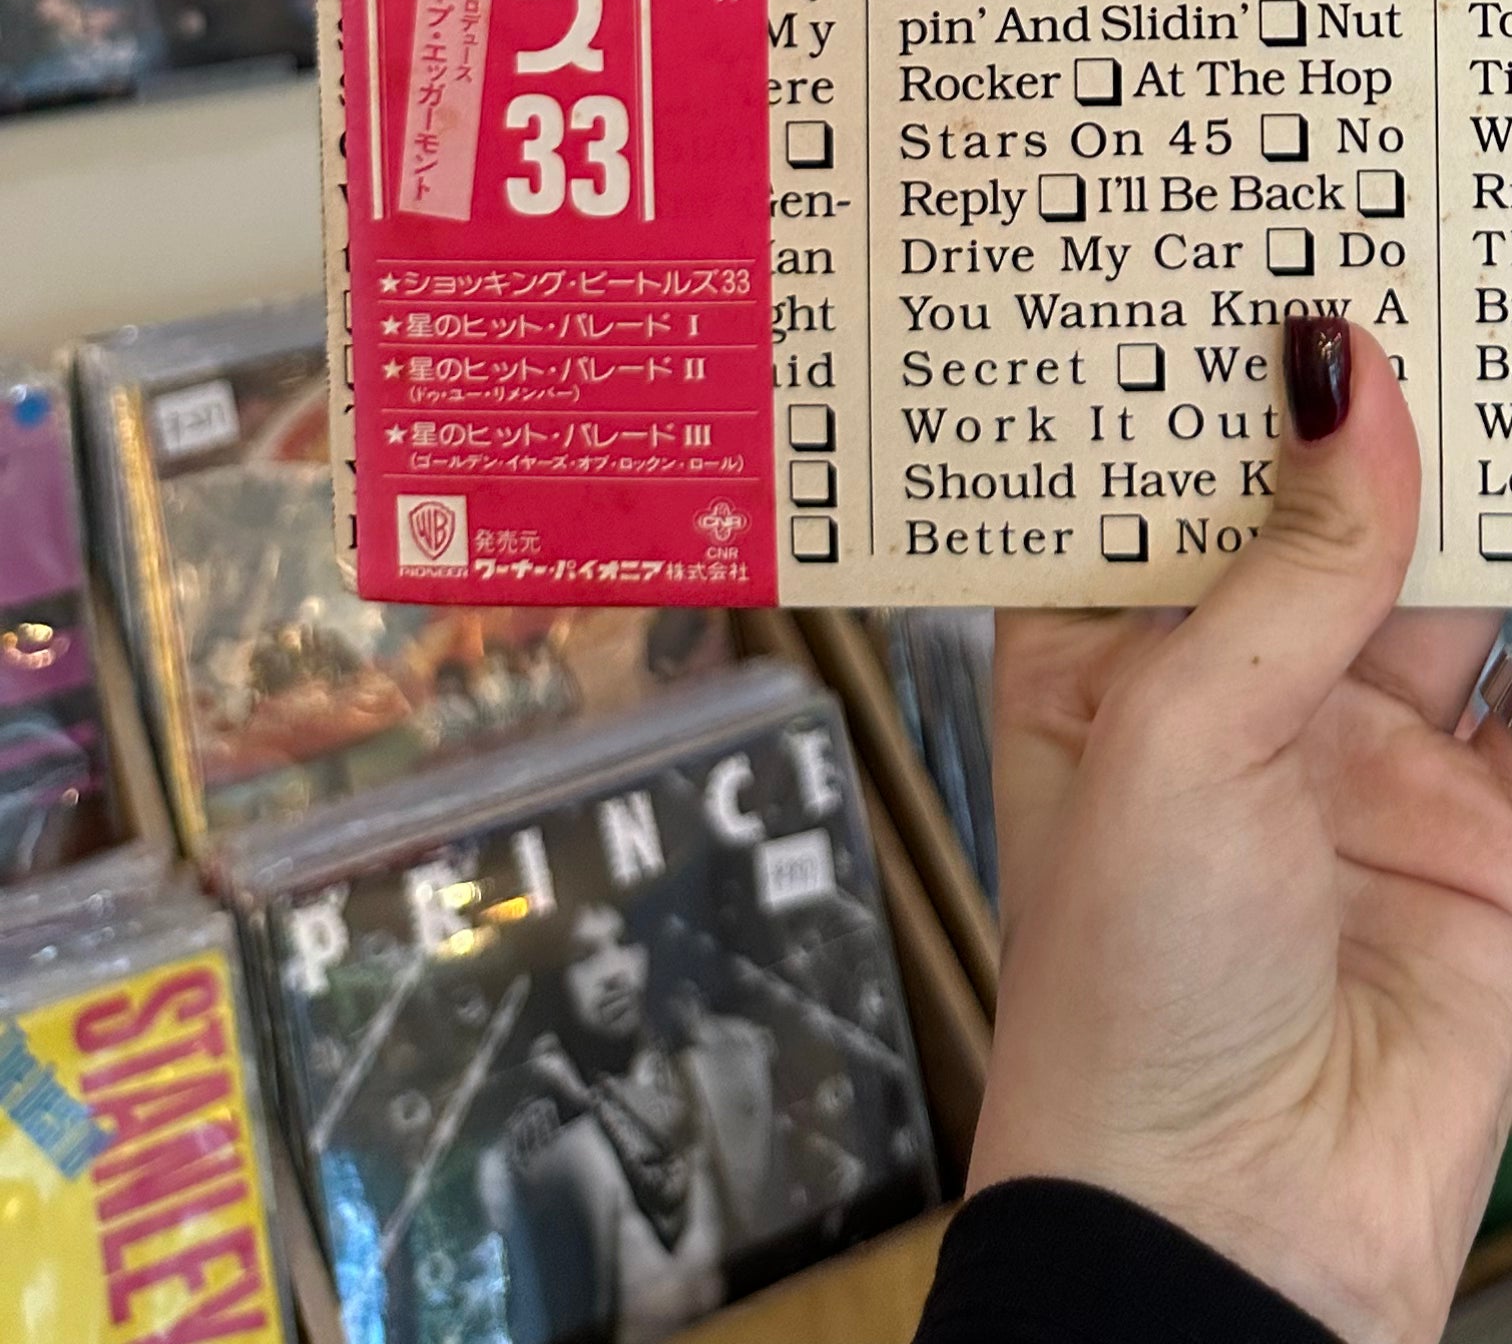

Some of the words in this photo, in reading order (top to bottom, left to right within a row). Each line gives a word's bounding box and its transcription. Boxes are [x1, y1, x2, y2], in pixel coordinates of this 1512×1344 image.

[898, 6, 986, 57] pin'
[994, 5, 1092, 44] And
[1101, 2, 1249, 42] Slidin'
[1317, 2, 1403, 39] Nut
[900, 123, 1047, 161] Stars
[1070, 121, 1144, 159] On
[1168, 117, 1232, 156] 45
[1336, 117, 1404, 154] No
[900, 238, 1035, 275] Drive
[1060, 235, 1132, 283] My
[1154, 233, 1244, 271] Car
[1338, 231, 1406, 268] Do
[898, 295, 991, 332] You
[1014, 293, 1187, 330] Wanna
[1373, 288, 1409, 325] A
[902, 350, 1087, 388] Secret
[1194, 345, 1269, 383] We
[901, 405, 1057, 444] Work
[1090, 405, 1135, 442] It
[1168, 403, 1281, 441] Out
[474, 528, 542, 554] 発売元
[706, 546, 739, 560] CNR
[905, 520, 1074, 556] Better
